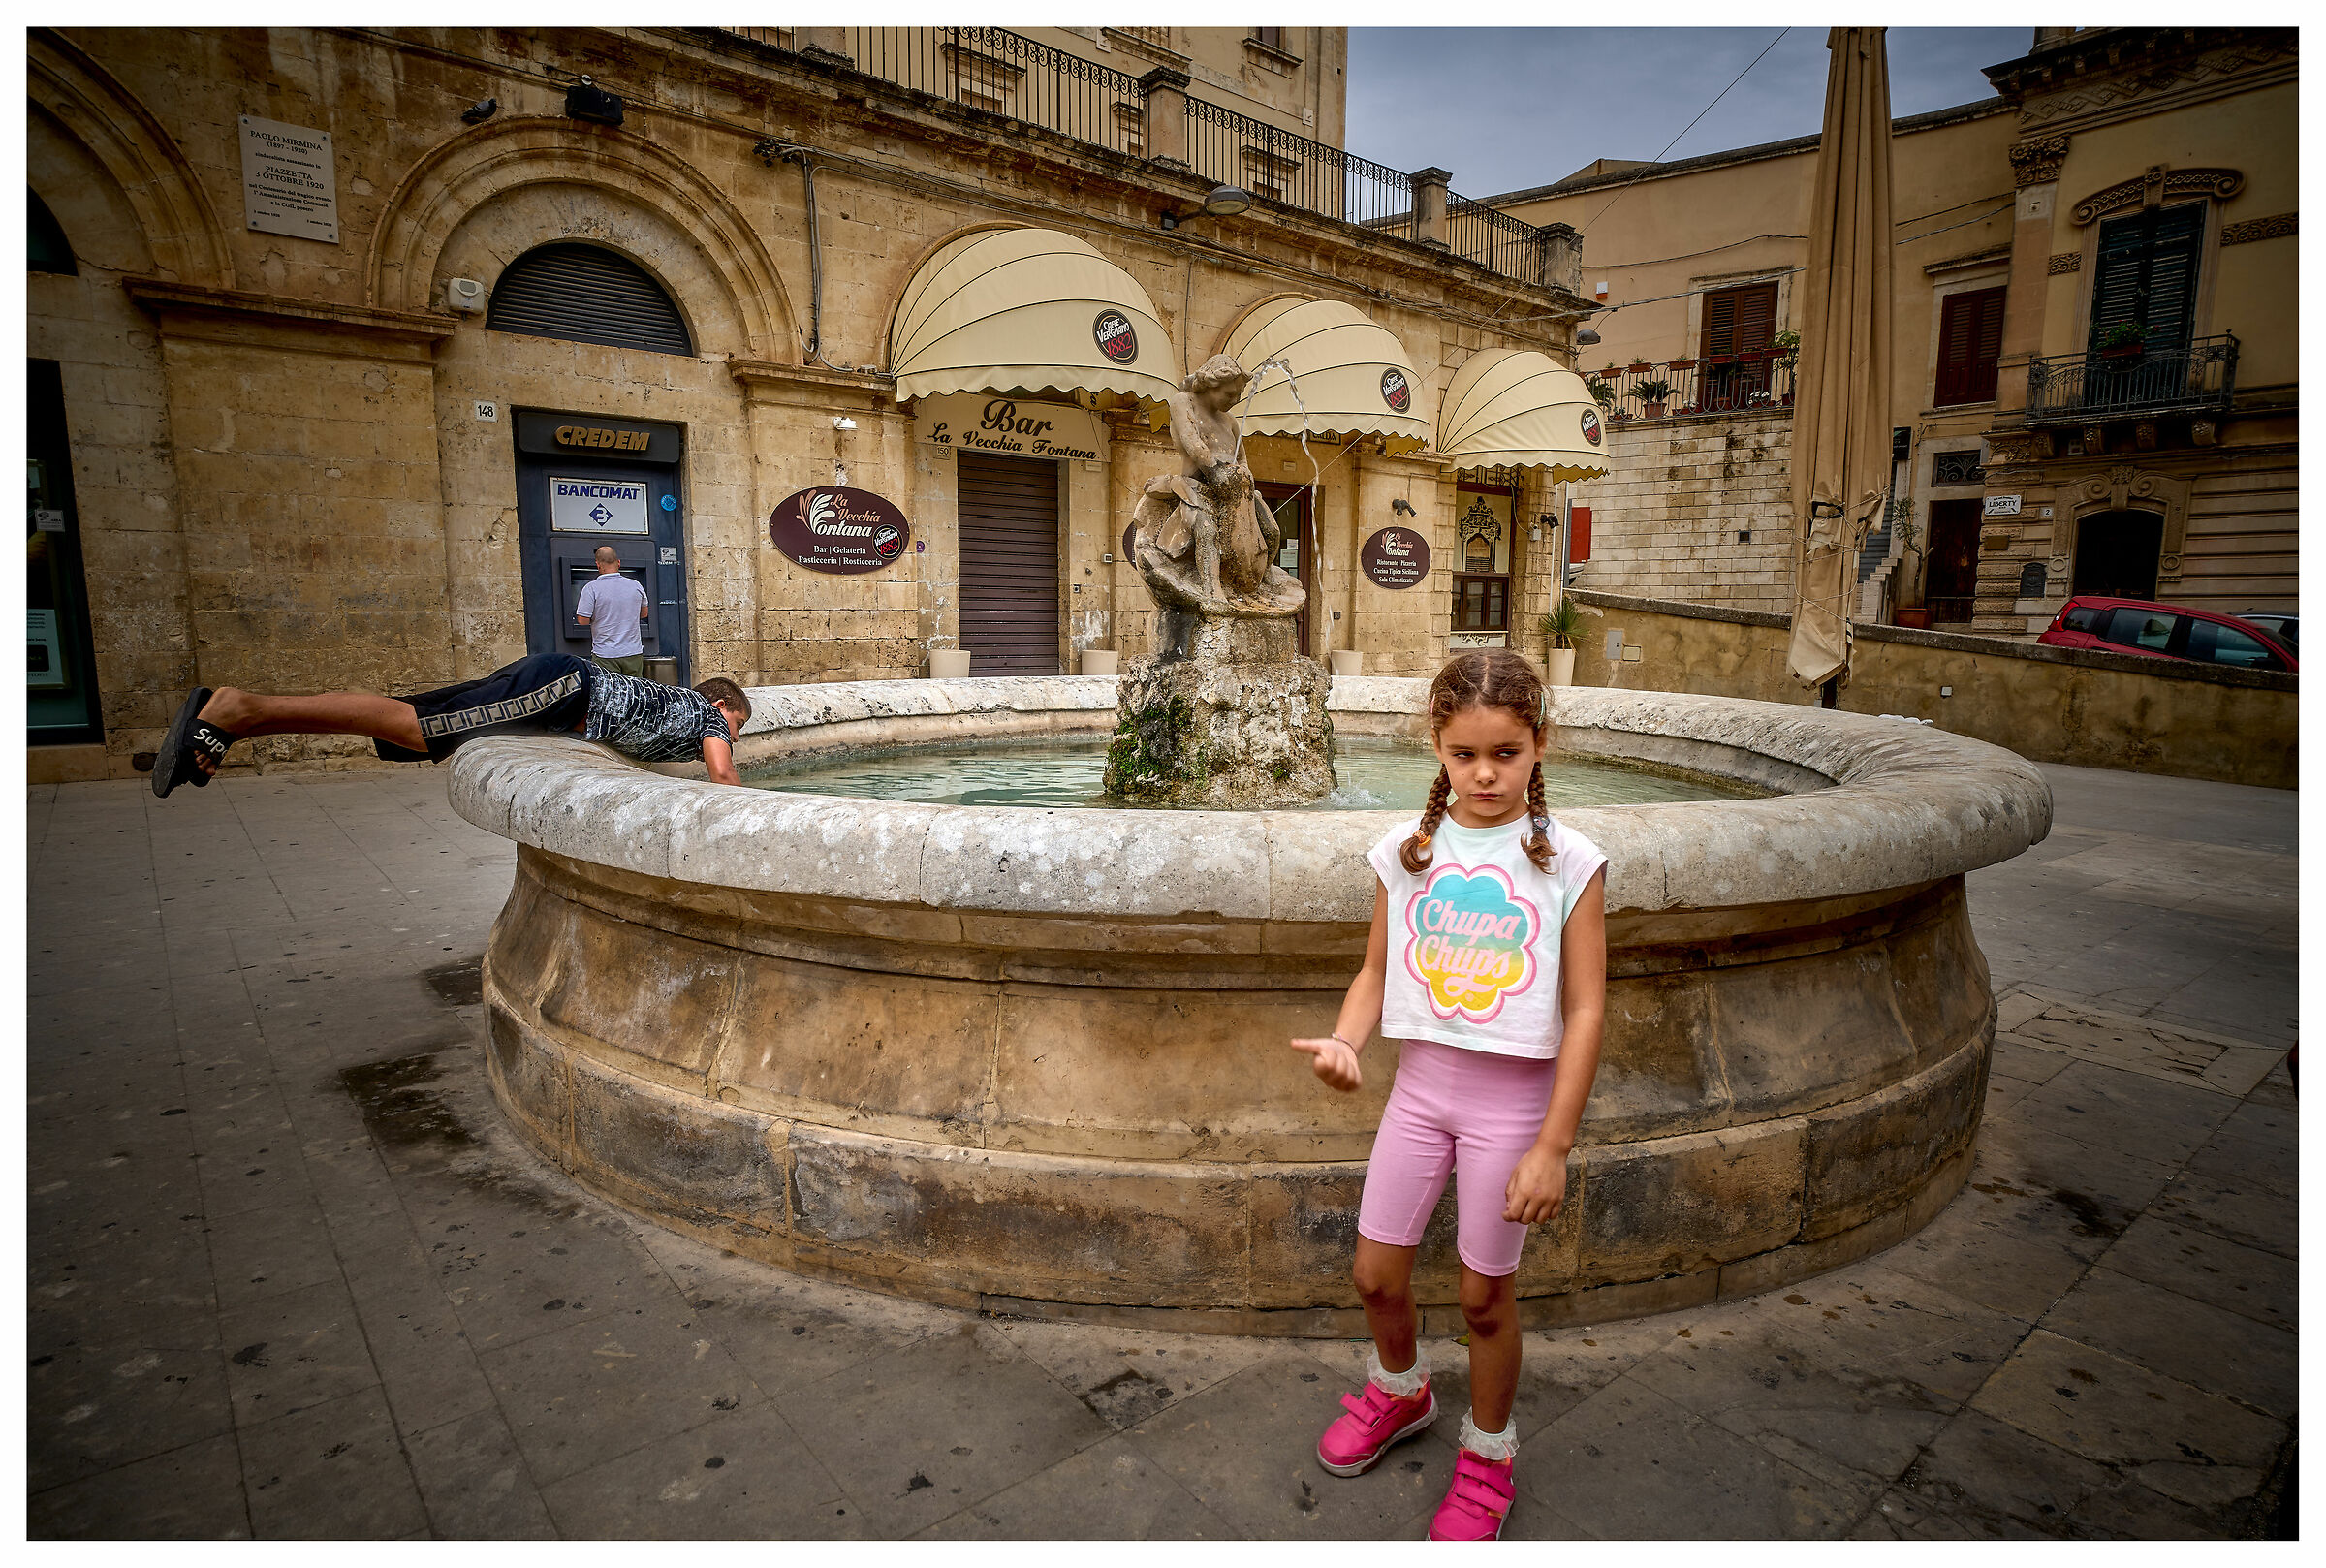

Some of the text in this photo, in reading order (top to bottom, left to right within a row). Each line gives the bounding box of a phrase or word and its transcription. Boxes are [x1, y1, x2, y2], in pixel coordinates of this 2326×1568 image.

[250, 130, 323, 151] PAOLO MIRMINA
[267, 141, 284, 149] (1897
[291, 146, 308, 155] 1920)
[263, 172, 304, 186] OTTOBRE
[306, 181, 324, 190] 1920
[266, 165, 313, 181] PIAZZETTA
[259, 191, 302, 203] Amministrazione
[1097, 322, 1130, 343] VERGNANO
[1107, 333, 1132, 356] 1882
[1390, 387, 1407, 407] 1882
[477, 405, 494, 417] 148
[980, 399, 1054, 436] Bar
[555, 426, 651, 451] CREDEM
[927, 422, 1097, 460] La Vecchia Fontana
[937, 446, 949, 455] 150
[557, 484, 640, 500] BANCOMAT
[830, 494, 849, 508] La
[838, 511, 881, 523] Vecchia
[814, 545, 866, 554] Bar Gelateria
[880, 538, 898, 555] 1882
[798, 556, 882, 566] Pasticceria Rosticceria
[1422, 899, 1521, 946] Chupa
[1420, 934, 1513, 997] Chups
